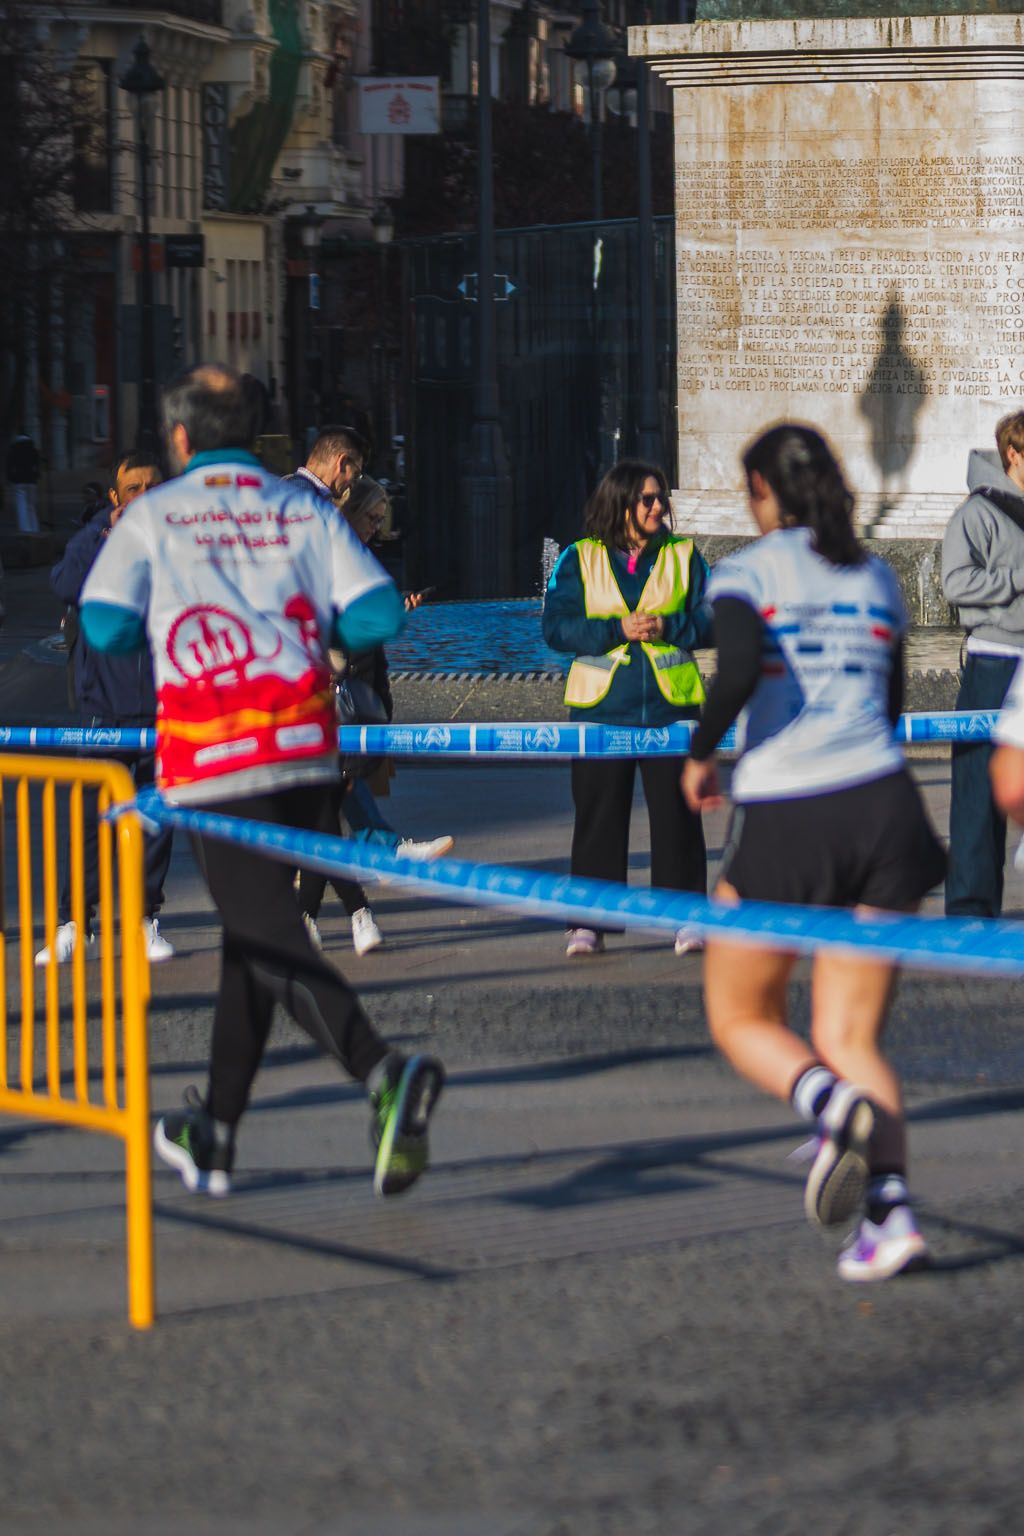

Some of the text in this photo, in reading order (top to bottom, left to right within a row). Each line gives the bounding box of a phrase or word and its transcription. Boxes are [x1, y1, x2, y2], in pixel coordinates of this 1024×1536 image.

[779, 250, 785, 261] Y
[830, 251, 835, 261] Y
[839, 251, 855, 261] REY
[859, 251, 871, 262] DE
[967, 251, 974, 262] A
[979, 251, 991, 262] SV
[690, 262, 733, 273] NOTABLES
[939, 265, 998, 276] CIENTIFICOS
[1005, 265, 1012, 276] Y
[753, 275, 766, 286] DE
[771, 276, 784, 287] LA
[791, 277, 844, 288] SOCIEDAD
[852, 277, 857, 288] Y
[863, 277, 873, 289] EL
[877, 278, 919, 289] FOMENTO
[924, 278, 936, 289] DE
[941, 278, 958, 289] LAS
[748, 288, 758, 300] DE
[763, 288, 778, 300] LAS
[782, 289, 831, 301] SOCIEDADES
[835, 290, 890, 302] ECONOMICAS
[895, 291, 905, 302] DE
[911, 291, 945, 302] AMIGOS
[751, 301, 756, 313] Y
[762, 301, 772, 313] EL
[778, 302, 840, 314] DESARROLLO
[845, 303, 857, 314] DE
[863, 304, 875, 314] LA
[937, 304, 947, 315] DE
[975, 305, 1021, 316] PVERTOS
[706, 315, 717, 326] LA
[790, 315, 801, 327] DE
[806, 316, 844, 327] CANALES
[849, 316, 855, 328] Y
[842, 343, 857, 354] LAS
[729, 354, 740, 365] EL
[744, 355, 827, 366] EMBELLECIMIENTO
[832, 356, 845, 367] DE
[850, 356, 867, 368] LAS
[1008, 357, 1015, 369] Y
[713, 367, 724, 378] DE
[730, 367, 769, 379] MEDIDAS
[774, 368, 823, 379] HIGIENICAS
[829, 368, 835, 380] Y
[840, 368, 852, 380] DE
[857, 369, 899, 381] LIMPIEZA
[903, 369, 915, 381] DE
[920, 370, 937, 381] LAS
[997, 370, 1011, 382] LA
[695, 379, 705, 391] EN
[710, 379, 720, 391] LA
[725, 379, 751, 391] CORTE
[754, 380, 766, 391] LO
[769, 381, 819, 392] PROCLAMAN
[823, 381, 849, 393] COMO
[853, 382, 864, 394] EL
[866, 382, 892, 394] MEJOR
[896, 383, 934, 395] ALCALDE
[938, 383, 949, 395] DE
